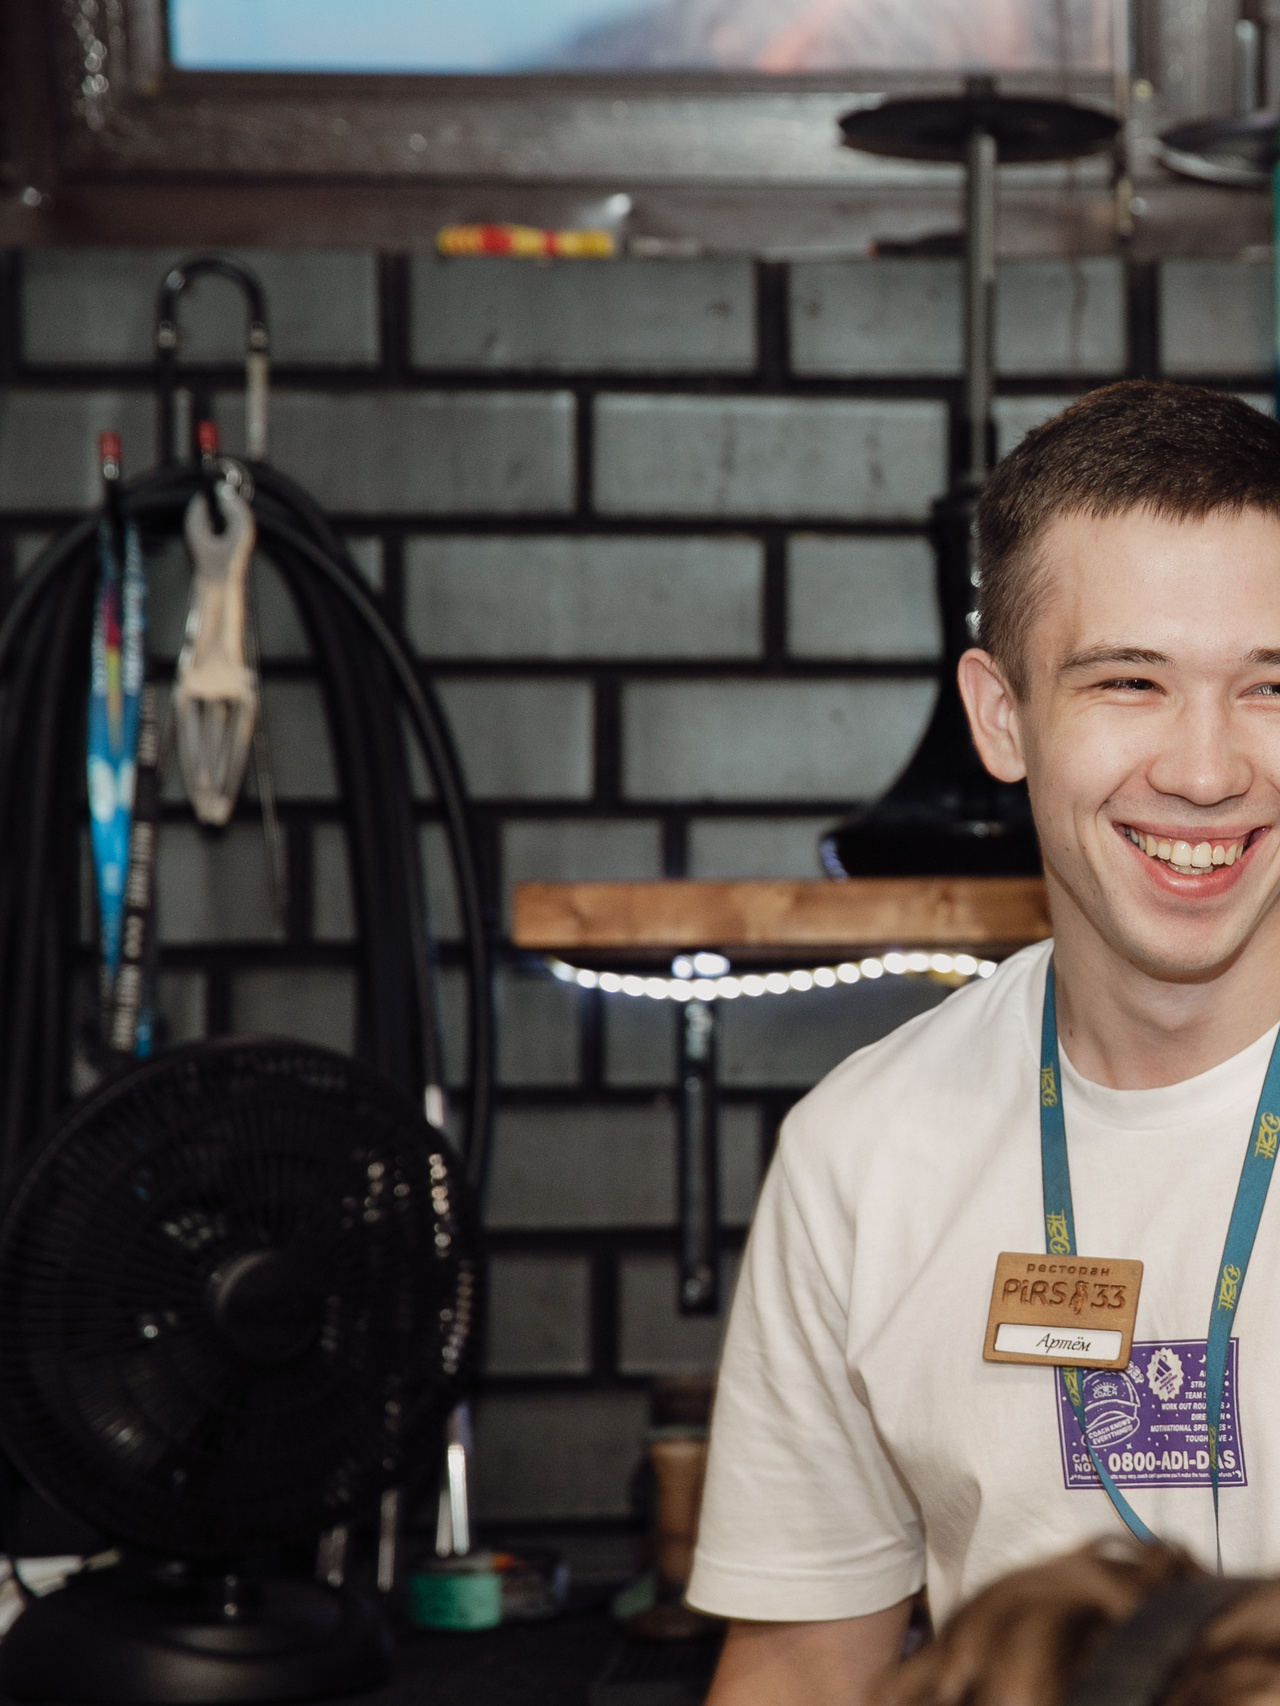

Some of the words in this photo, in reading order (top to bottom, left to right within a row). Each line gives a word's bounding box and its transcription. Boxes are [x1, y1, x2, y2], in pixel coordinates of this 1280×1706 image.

[1026, 1263, 1111, 1277] ресторан
[1090, 1284, 1127, 1310] 33
[1035, 1332, 1092, 1354] Артём
[1088, 1427, 1110, 1439] COACH
